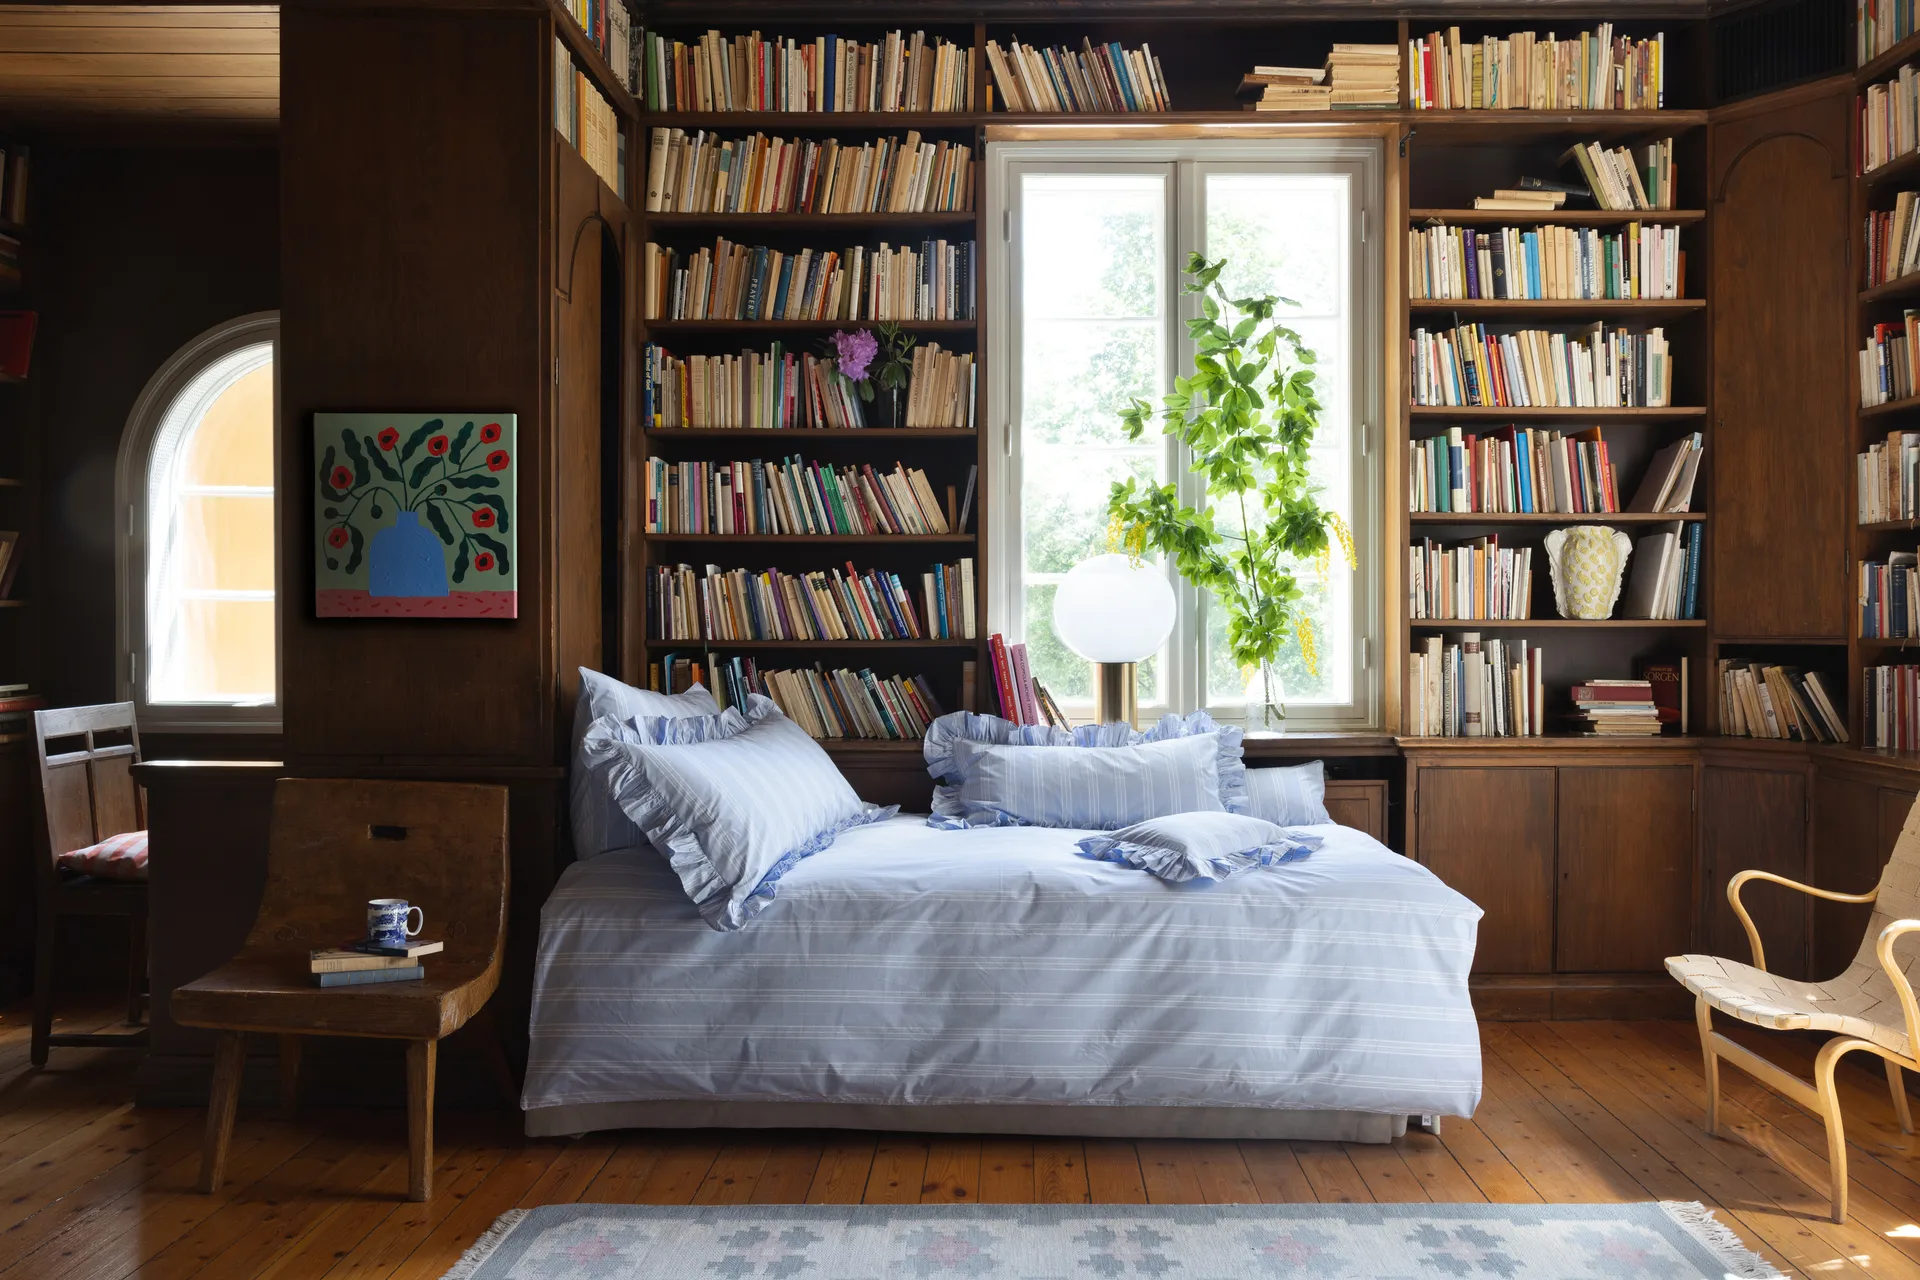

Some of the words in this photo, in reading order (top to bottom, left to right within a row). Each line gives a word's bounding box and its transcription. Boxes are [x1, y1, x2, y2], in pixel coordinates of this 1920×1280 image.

[747, 278, 758, 310] PRAYER
[645, 371, 651, 379] of
[1643, 671, 1680, 682] SORGEN
